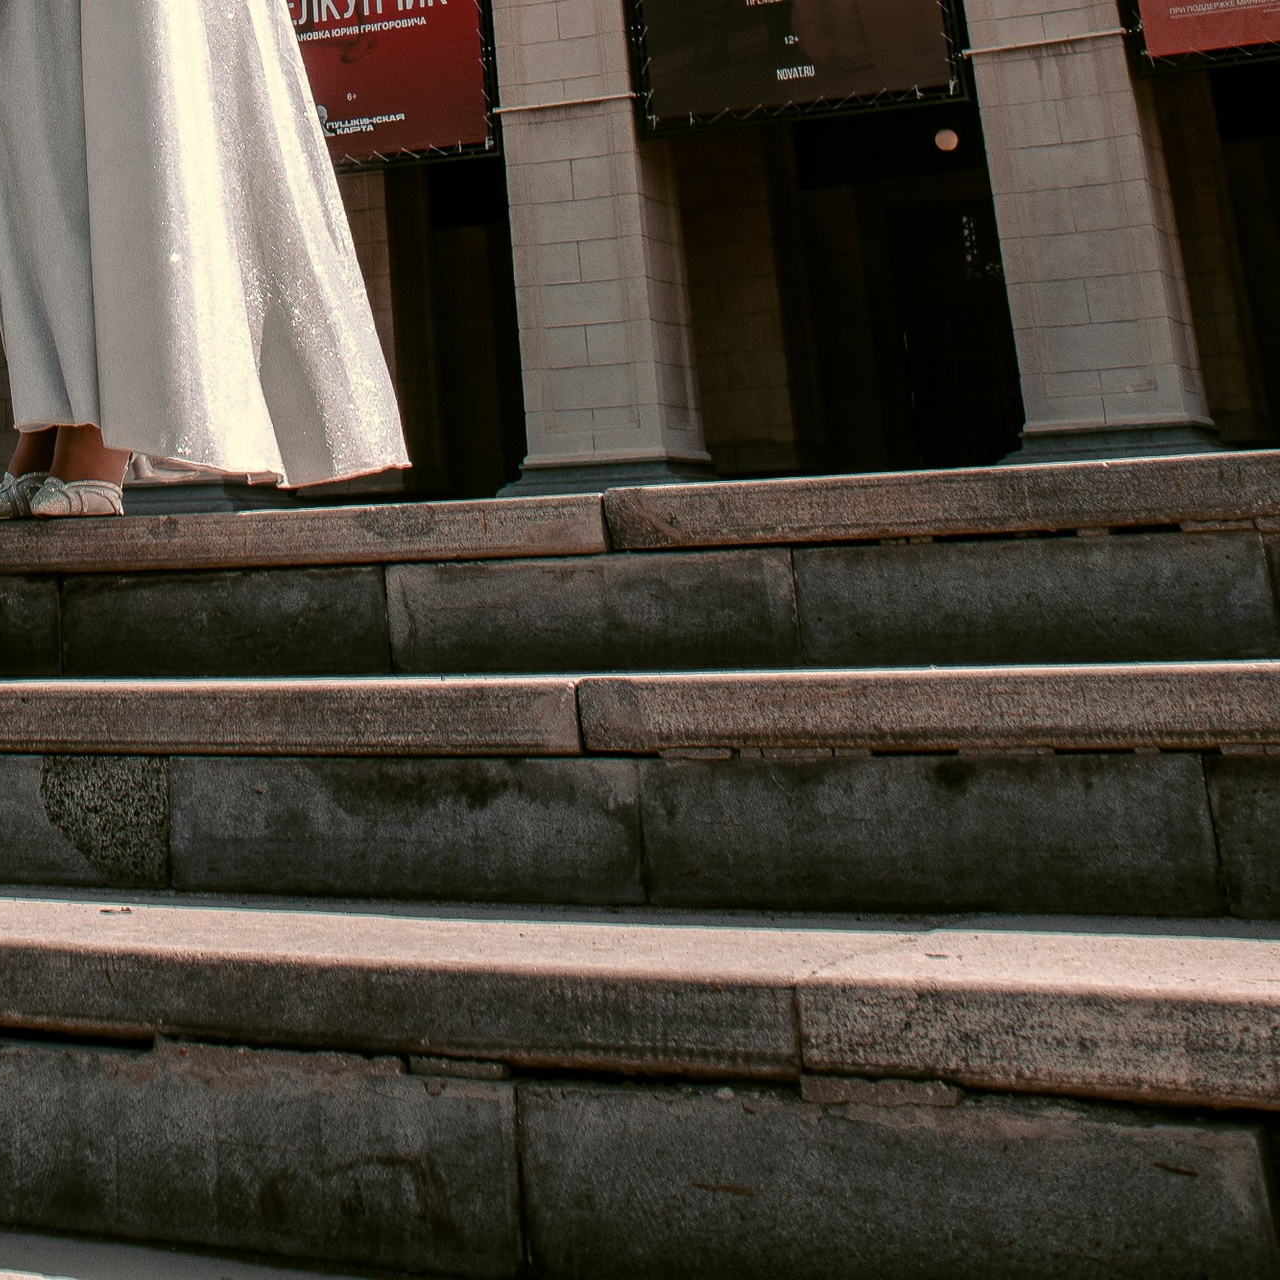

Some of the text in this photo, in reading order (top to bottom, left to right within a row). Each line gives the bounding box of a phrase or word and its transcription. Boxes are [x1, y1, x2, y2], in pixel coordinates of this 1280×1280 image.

[1169, 6, 1186, 15] ПРИ
[1186, 0, 1235, 12] ПОДДЕРЖКЕ
[331, 25, 359, 38] ЮРИЯ
[360, 16, 427, 34] ГРИГОРОВИЧА
[784, 35, 799, 45] 12+
[776, 64, 816, 81] NOVAT.RU
[346, 92, 358, 101] 6+
[326, 113, 406, 129] ПУШКИНСКАЯ
[336, 124, 374, 135] КАРТА
